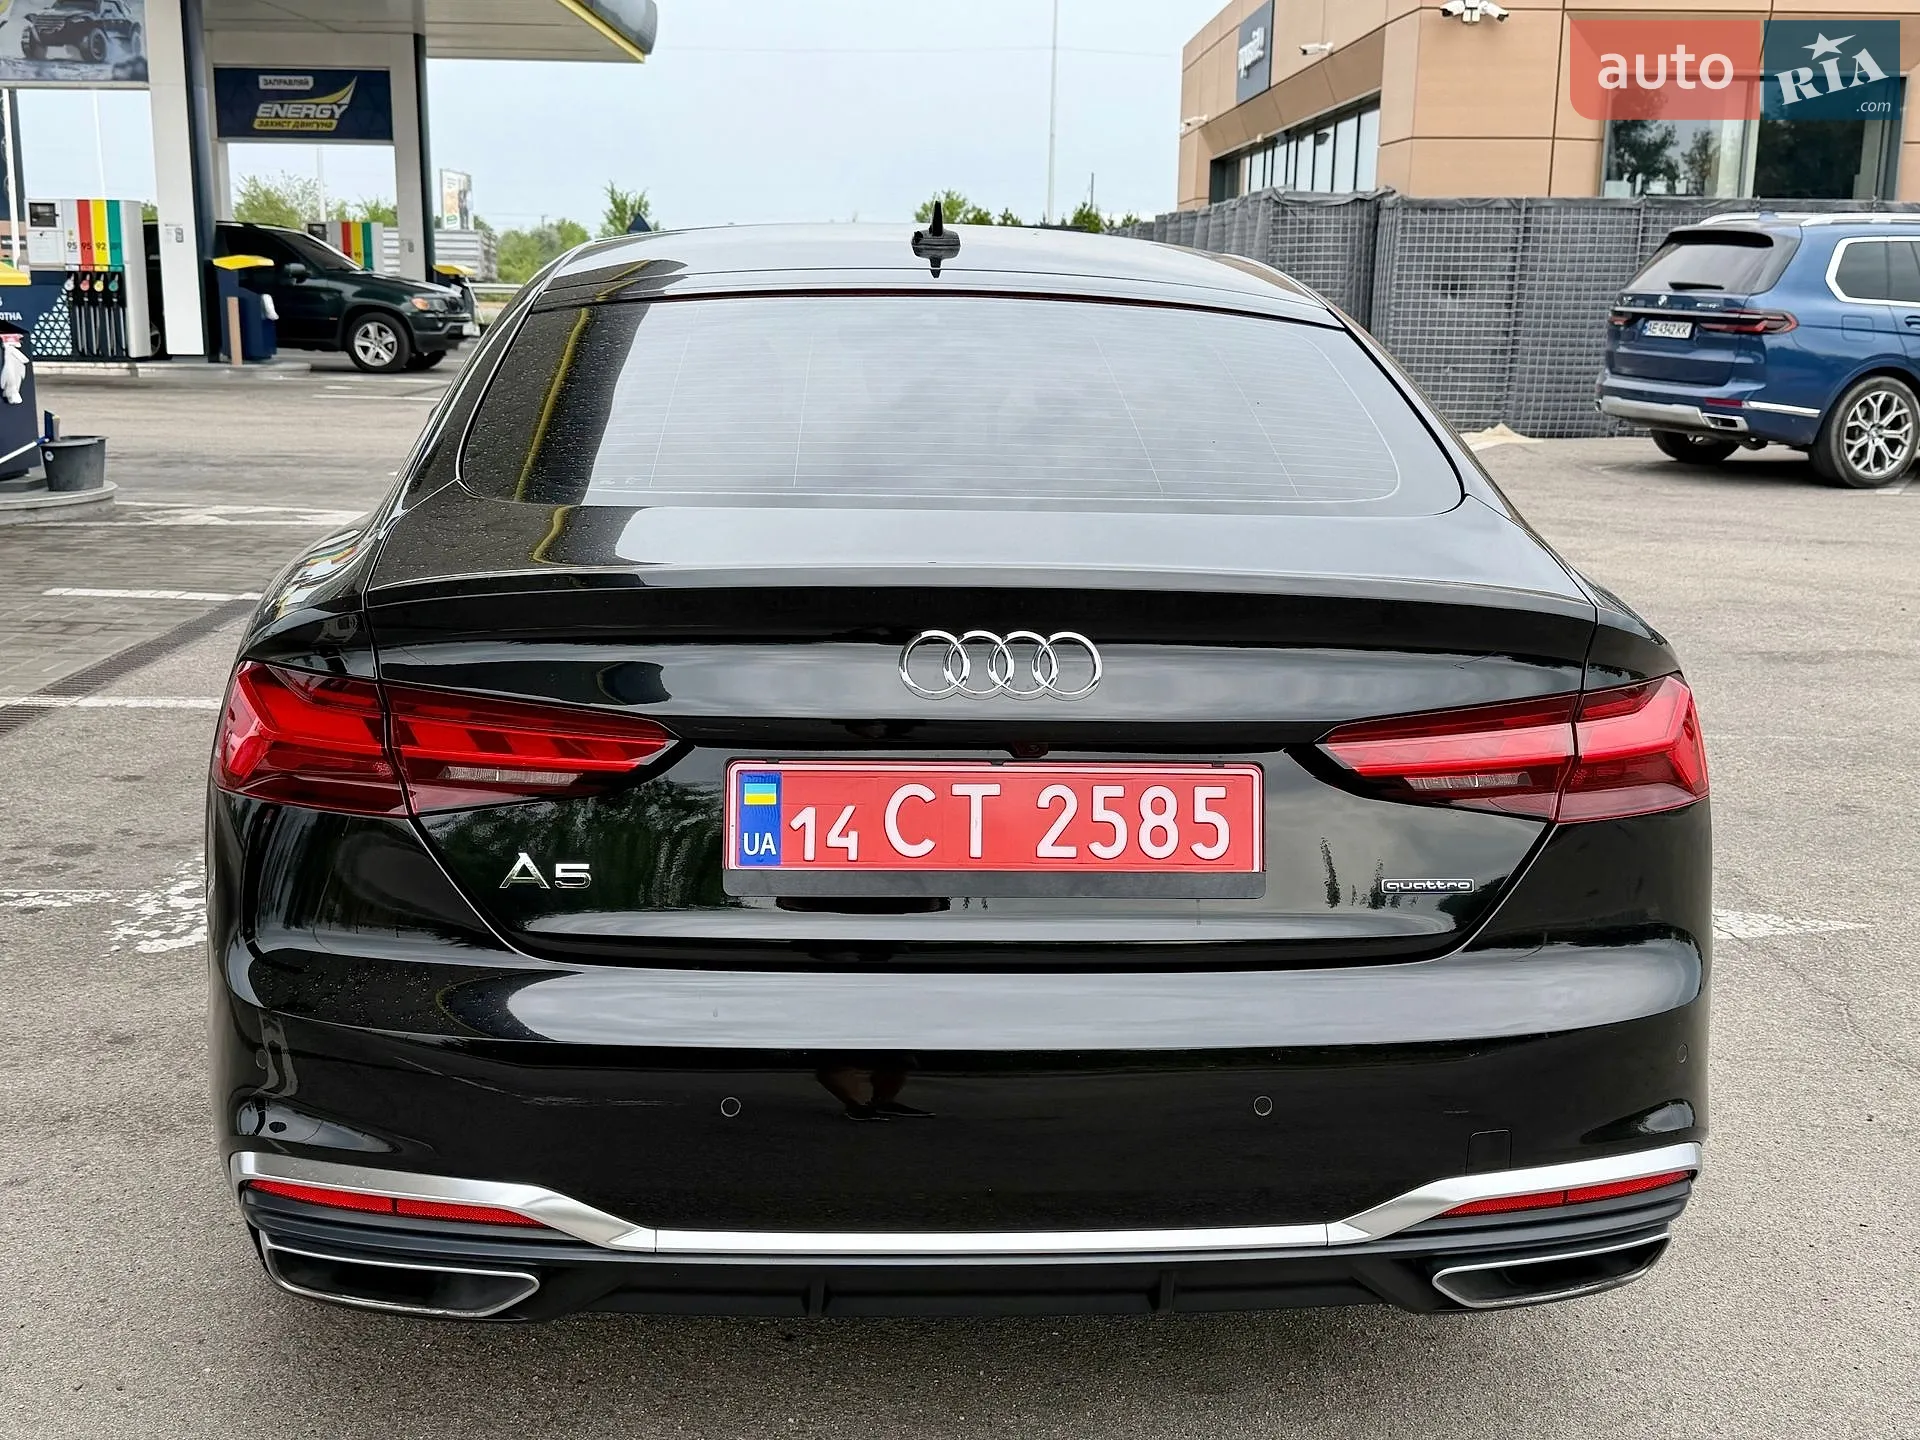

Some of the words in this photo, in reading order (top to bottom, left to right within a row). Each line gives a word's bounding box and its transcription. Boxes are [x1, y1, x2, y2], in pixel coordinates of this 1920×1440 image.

[263, 77, 310, 87] ЗАПРАВЛЯЙ
[256, 103, 348, 119] ENERGY
[257, 120, 291, 128] ЗАХИСТ
[292, 121, 334, 130] ДВИГУНА
[66, 241, 77, 250] 95
[81, 241, 92, 251] 95
[96, 241, 106, 250] 92
[789, 805, 859, 861] 14
[883, 783, 1001, 858] CT
[1035, 785, 1231, 860] 2585
[743, 832, 777, 856] UA
[499, 852, 592, 889] A5
[1386, 880, 1471, 892] quattro
